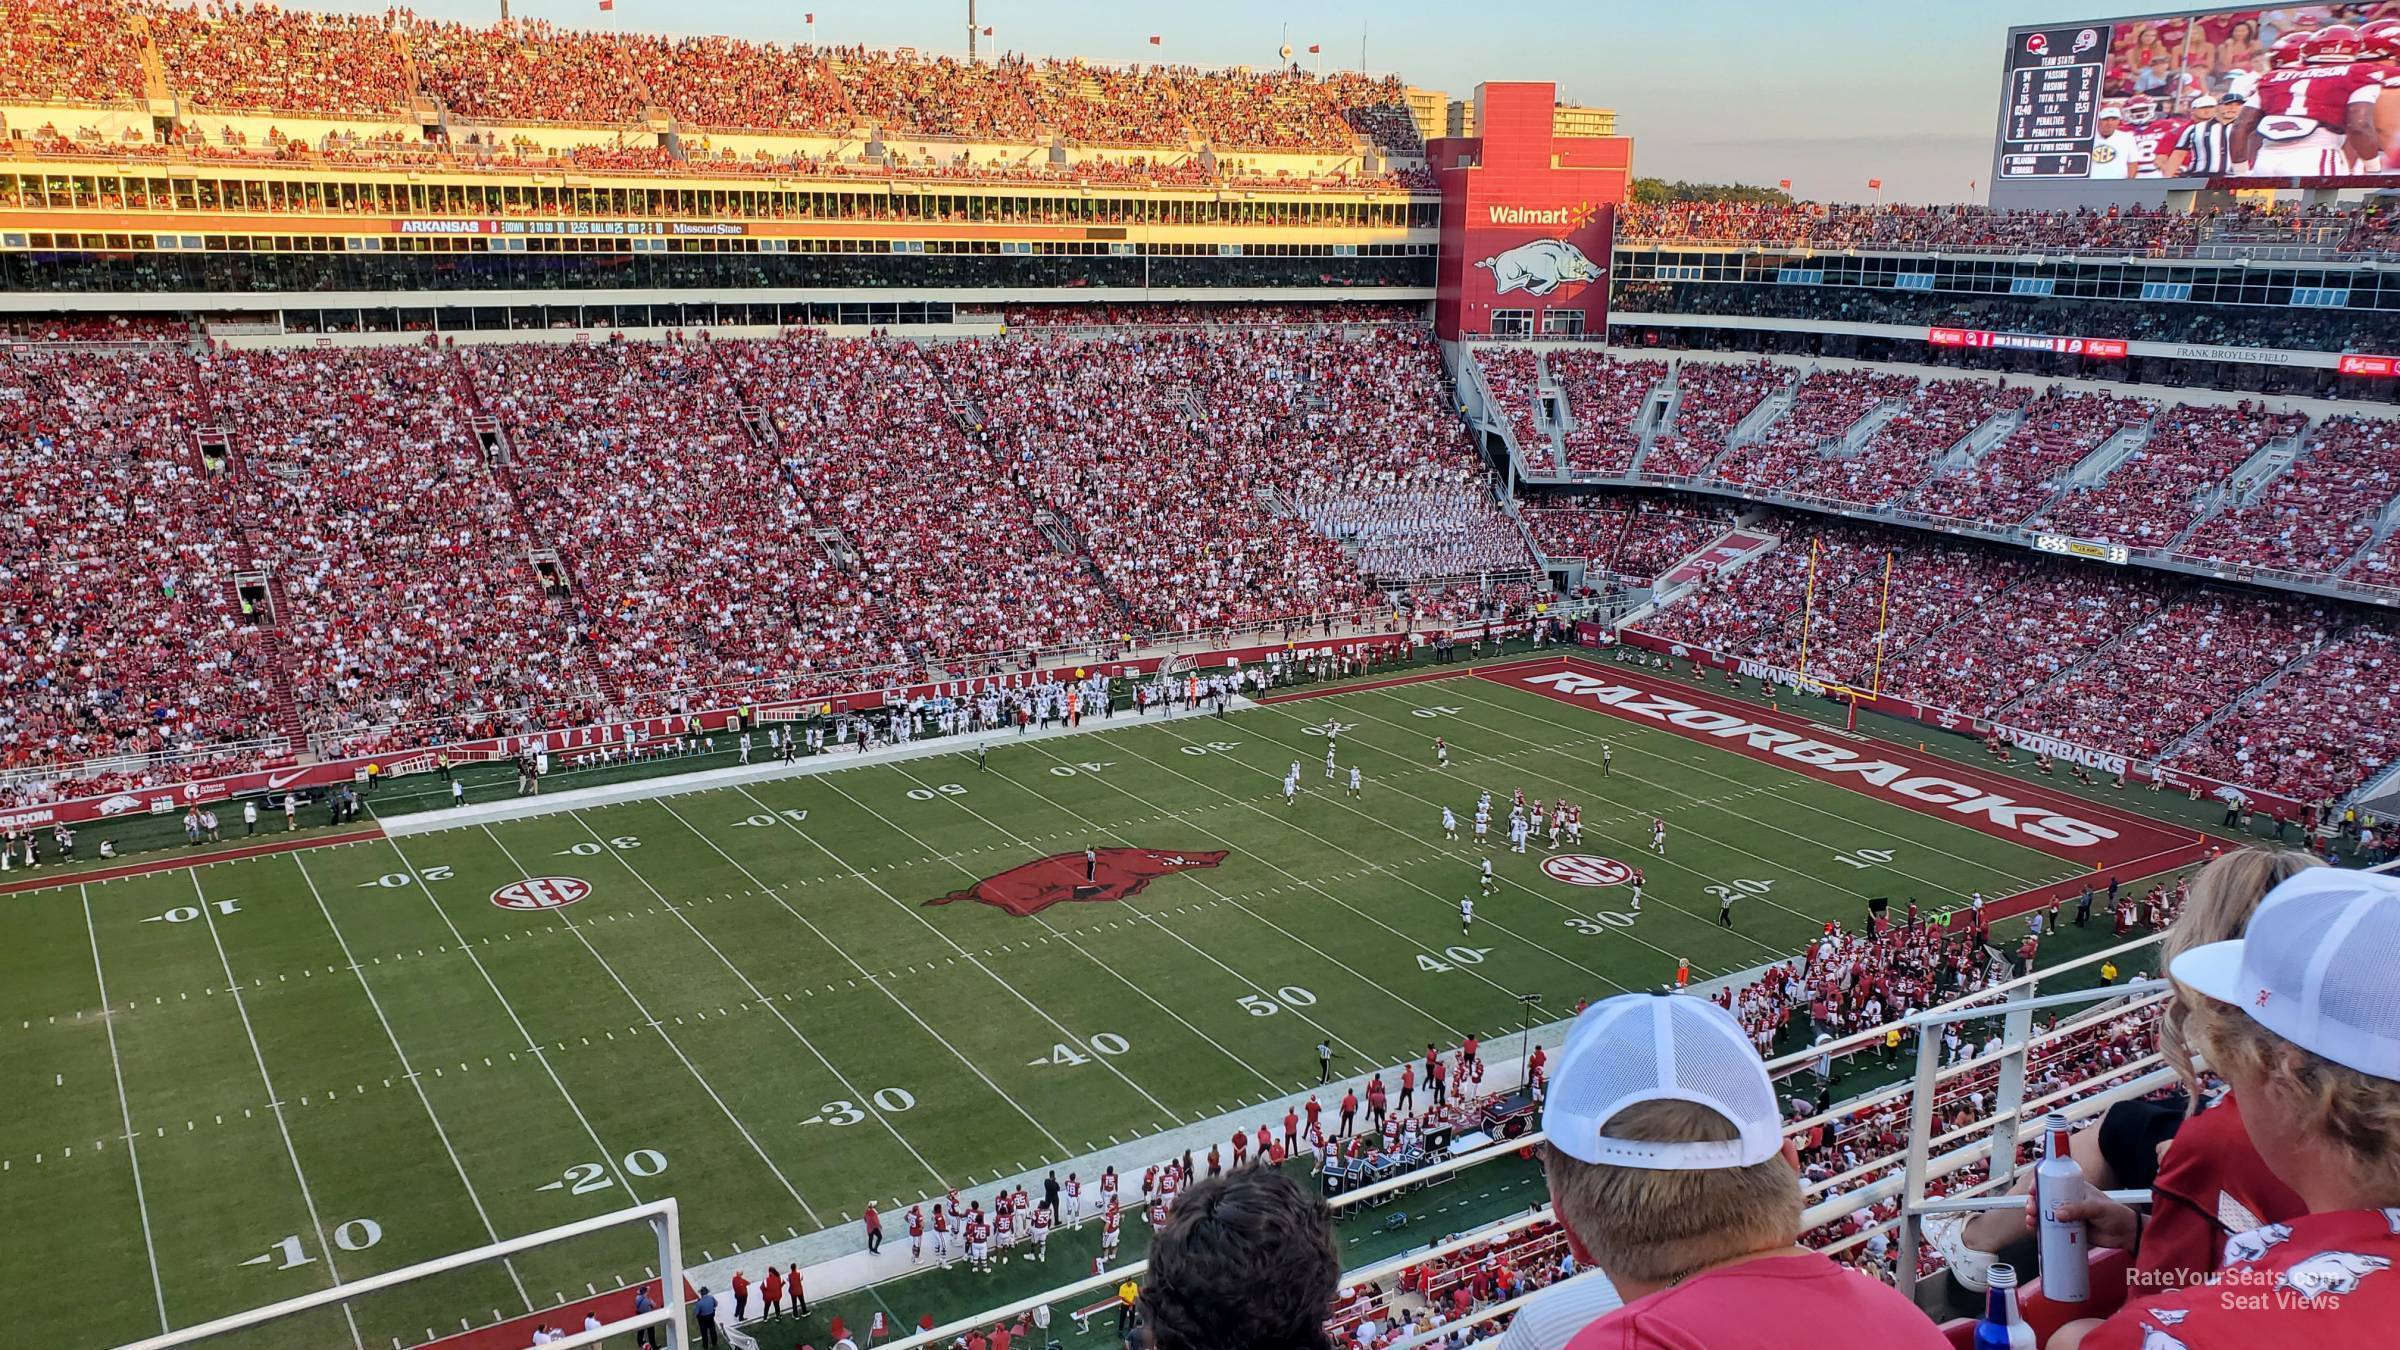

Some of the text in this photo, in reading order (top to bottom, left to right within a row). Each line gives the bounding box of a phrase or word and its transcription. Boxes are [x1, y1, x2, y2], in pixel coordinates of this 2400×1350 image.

[2041, 55, 2076, 66] TEAM STATS
[2271, 65, 2351, 82] JEFFERSON
[2285, 78, 2312, 116] 1
[2031, 128, 2055, 138] PENALTY
[2036, 116, 2066, 126] PENALTIES
[2092, 146, 2114, 162] SEC
[401, 221, 479, 232] ARKANSAS
[505, 222, 525, 233] DOWN
[1489, 206, 1569, 225] Walmart
[673, 223, 742, 235] Missouri State
[2176, 347, 2289, 363] FRANK BROYLES FIELD
[2037, 536, 2068, 553] 12:55
[2108, 547, 2126, 561] 33
[934, 670, 1054, 698] ARKANSAS
[1522, 669, 2120, 848] RAZORBACKS
[1993, 724, 2127, 775] RAZORBACKS
[907, 783, 969, 801] 50
[571, 835, 643, 857] 30
[1548, 856, 1623, 884] SEC
[1833, 847, 1893, 870] 10
[378, 864, 456, 889] 20
[508, 878, 582, 909] SEC
[164, 897, 241, 924] 10
[1563, 910, 1637, 936] 30
[1415, 945, 1486, 974] 40
[1235, 985, 1318, 1017] 50
[1052, 1032, 1131, 1068] 40
[820, 1085, 917, 1128] 30
[563, 1148, 669, 1197] 20
[268, 1216, 384, 1272] 10
